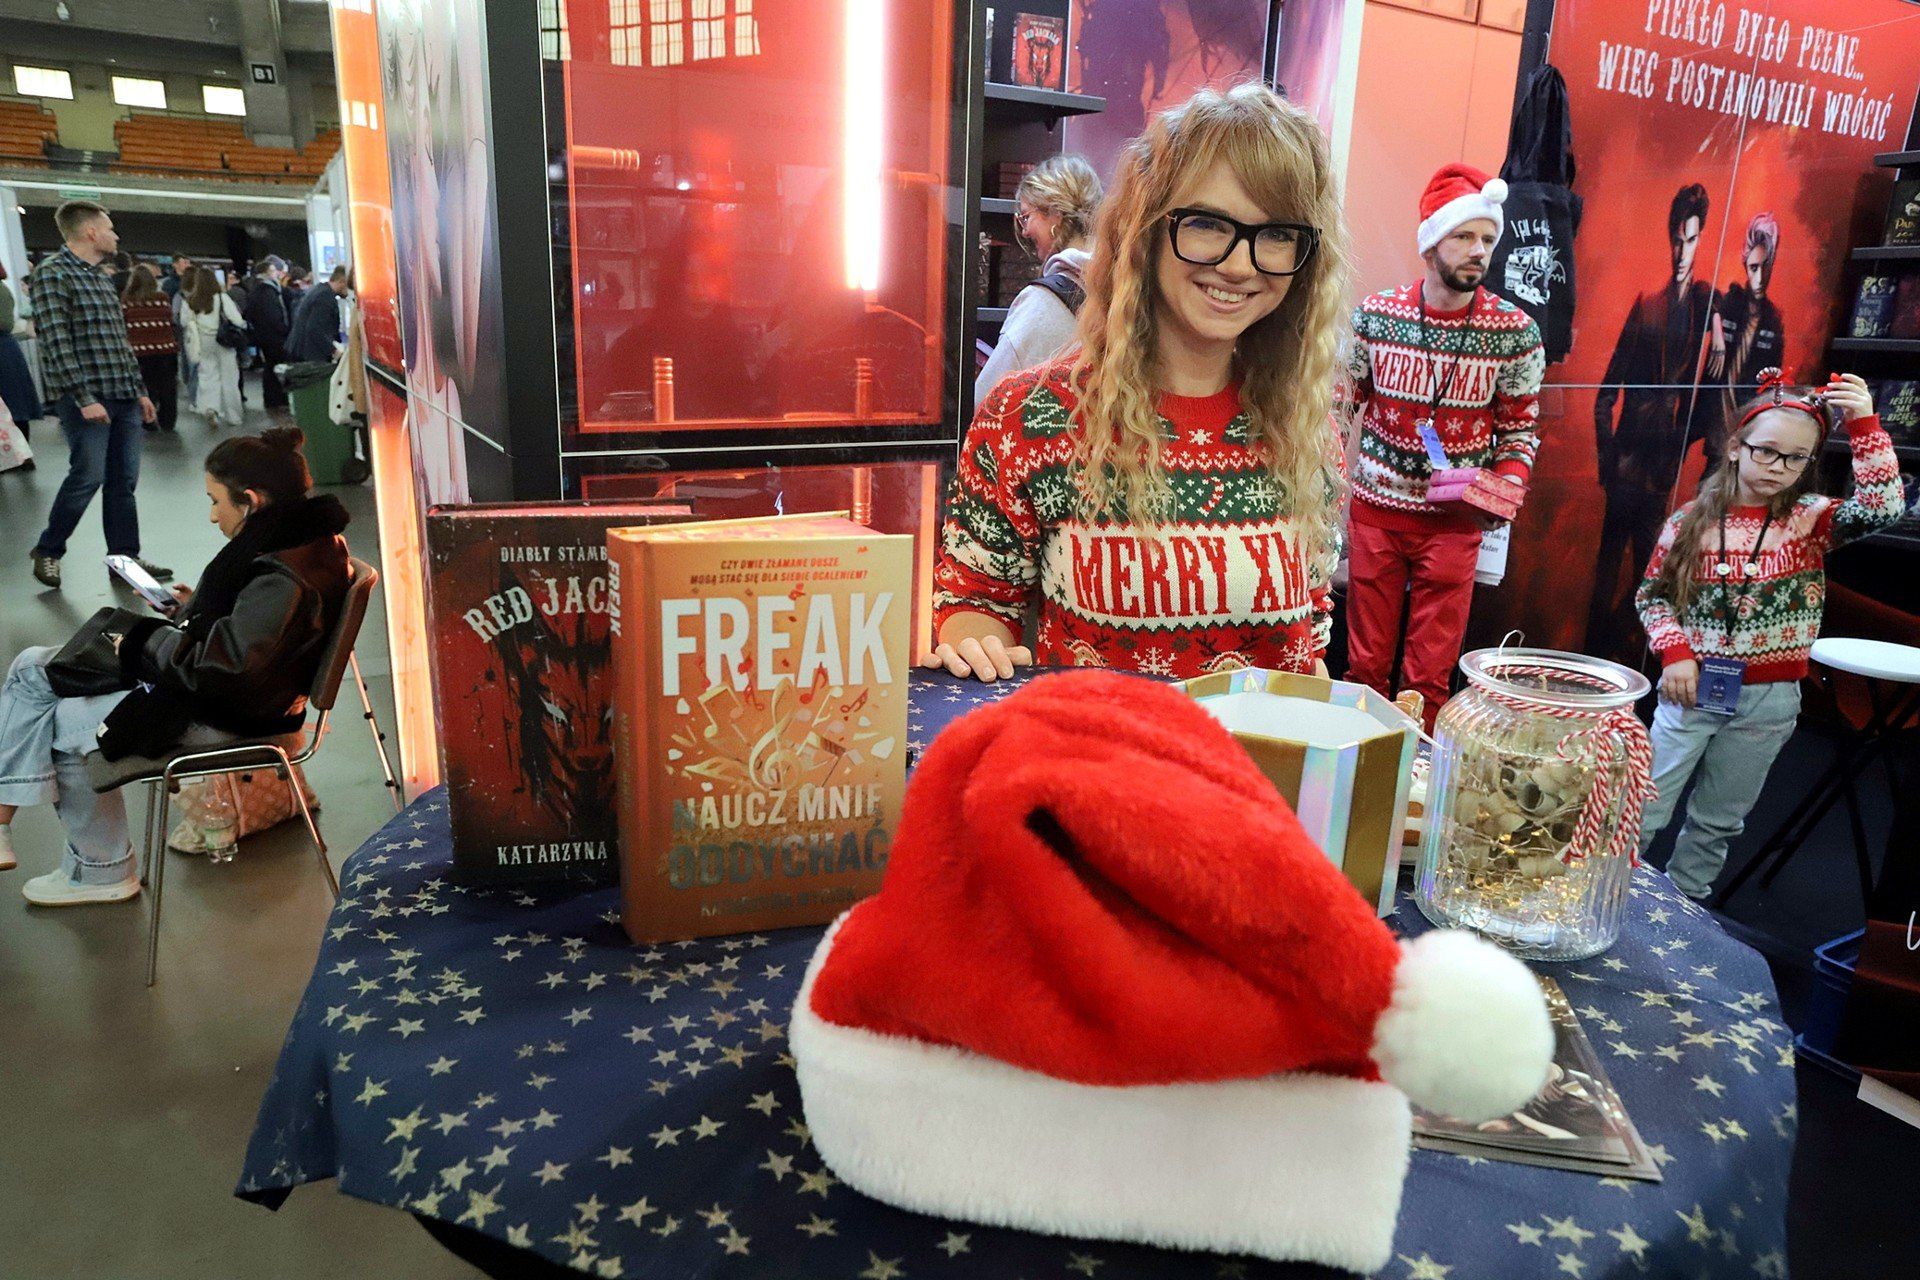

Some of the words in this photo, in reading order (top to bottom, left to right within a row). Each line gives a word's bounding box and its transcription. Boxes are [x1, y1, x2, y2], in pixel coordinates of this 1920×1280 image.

[1645, 0, 1725, 48] PIEKŁO
[1734, 8, 1790, 63] BYŁO
[254, 67, 273, 80] B1
[1597, 41, 1659, 98] WIĘC
[1666, 57, 1816, 128] POSTANOWILI
[1822, 87, 1894, 142] WRÓCIĆ
[1374, 350, 1435, 397] MERRY
[1436, 359, 1495, 402] XMAS
[500, 546, 550, 562] DIABŁY
[719, 573, 743, 584] STAĆ
[744, 573, 759, 584] SIĘ
[761, 572, 778, 583] DLA
[721, 559, 738, 570] CZY
[765, 558, 807, 569] ZŁAMANE
[1070, 533, 1231, 618] MERRY
[463, 586, 533, 643] RED
[542, 576, 609, 616] JAC
[608, 559, 621, 637] FREAK
[660, 591, 895, 697] FREAK
[673, 789, 787, 832] NAUCZ
[798, 783, 883, 822] MNIE
[496, 841, 607, 865] KATARZYNA
[668, 820, 888, 890] ODDYCHAĆ
